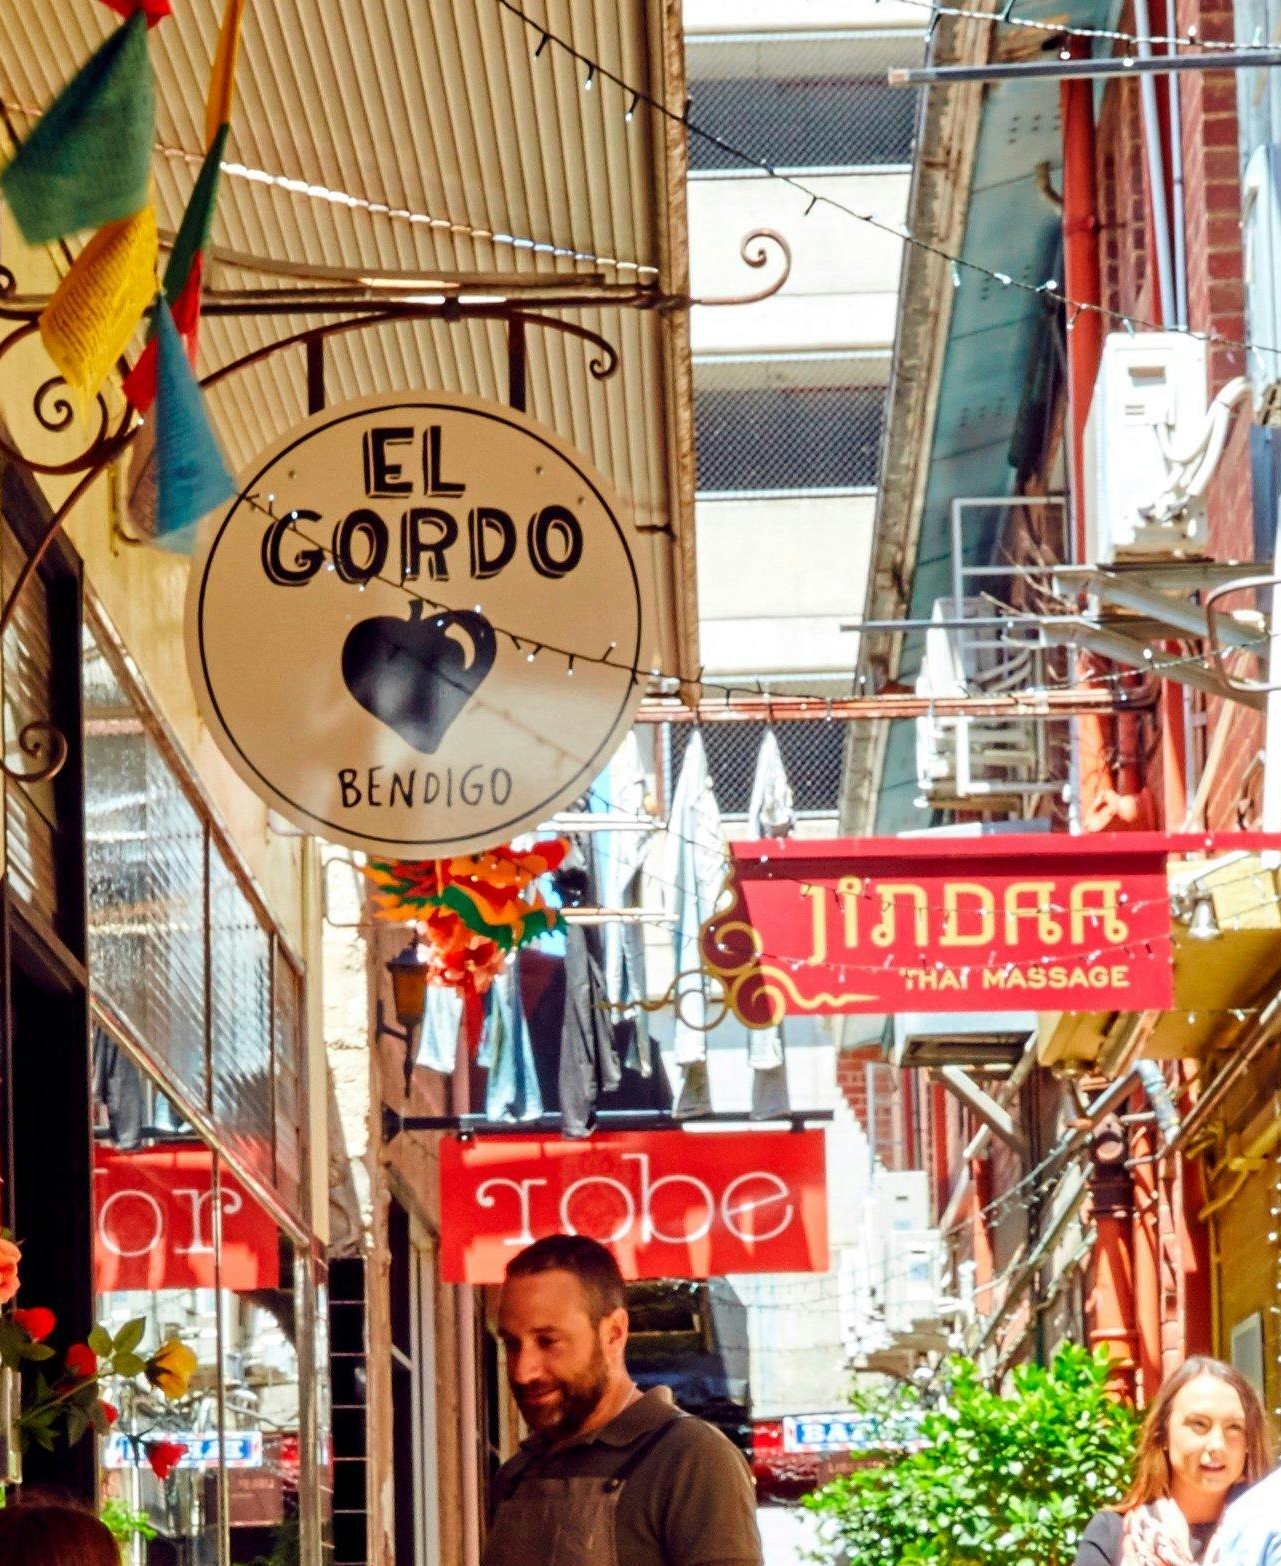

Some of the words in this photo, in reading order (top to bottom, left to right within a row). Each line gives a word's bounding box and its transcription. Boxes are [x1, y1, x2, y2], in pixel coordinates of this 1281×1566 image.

[362, 425, 467, 499] EL
[261, 505, 584, 587] GORDO
[337, 764, 513, 808] BENDIGO
[899, 967, 969, 990] THAI
[982, 966, 1131, 989] MASSAGE
